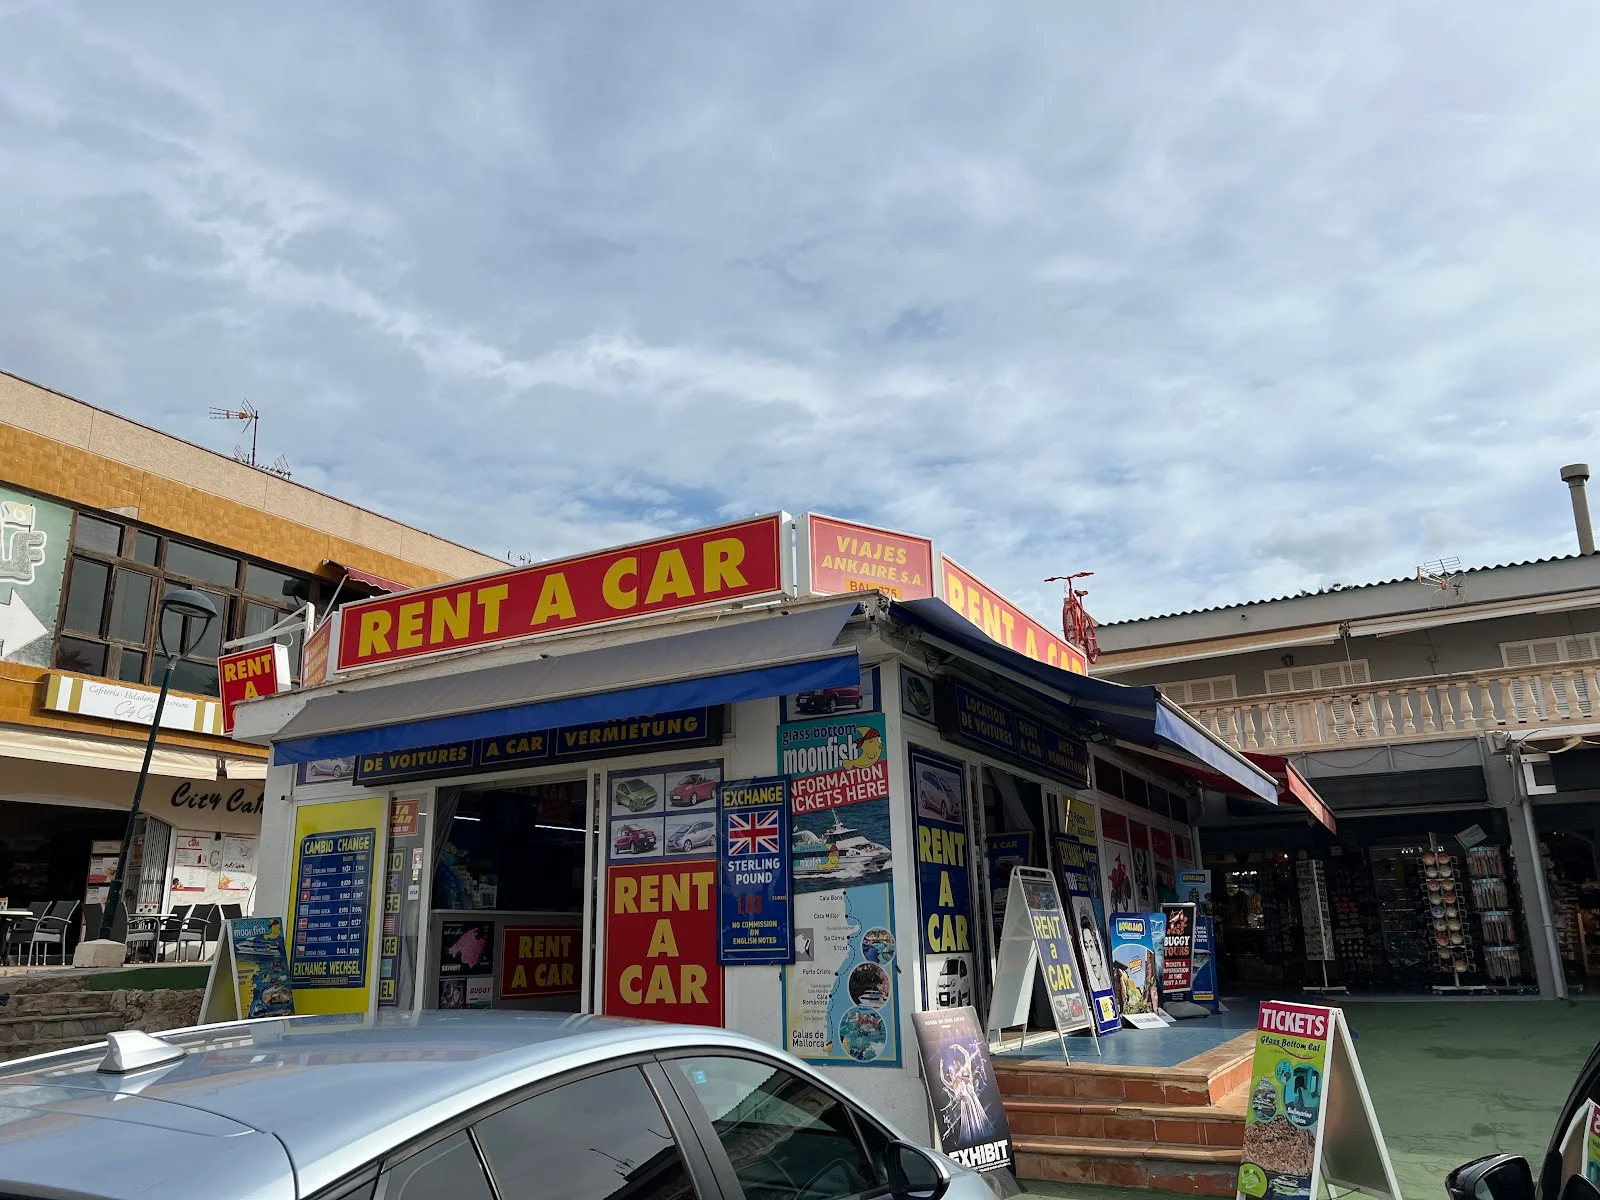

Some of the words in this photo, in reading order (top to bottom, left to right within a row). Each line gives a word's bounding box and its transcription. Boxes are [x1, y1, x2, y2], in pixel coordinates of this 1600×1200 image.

[837, 535, 907, 565] VIAJES
[357, 586, 509, 657] RENT
[530, 572, 576, 626] A
[602, 537, 749, 610] CAR
[947, 572, 1015, 650] RENT
[1025, 627, 1039, 662] A
[1047, 642, 1082, 676] CAR
[224, 654, 272, 683] RENT
[244, 681, 259, 701] A
[965, 695, 1006, 726] LOCATION
[565, 716, 699, 747] VERMIETUNG
[782, 728, 811, 746] glass
[813, 723, 857, 739] bottom
[960, 712, 973, 729] DE
[974, 716, 1013, 748] VOITURES
[1019, 720, 1039, 738] RENT
[363, 757, 383, 773] DE
[389, 745, 467, 769] VOITURES
[486, 742, 501, 757] A
[505, 736, 543, 755] CAR
[783, 734, 860, 774] moonfish
[1020, 739, 1026, 752] A
[1027, 742, 1043, 758] CAR
[1058, 739, 1074, 757] AUTO
[1048, 749, 1087, 777] VERMIETUNG
[791, 763, 884, 797] NFORMATION
[170, 782, 222, 810] City
[226, 788, 264, 814] Caf
[723, 786, 783, 807] EXCHANGE
[791, 789, 844, 814] ICKETS
[846, 780, 888, 803] HERE
[304, 840, 333, 854] CAMBIO
[337, 836, 370, 852] CHANGE
[919, 824, 965, 867] RENT
[1000, 840, 1018, 849] CAR
[728, 857, 781, 872] STERLING
[735, 871, 773, 885] POUND
[938, 870, 955, 907] A
[614, 871, 714, 914] RENT
[731, 921, 741, 929] NO
[741, 920, 778, 928] COMMISSION
[927, 913, 970, 953] CAR
[1034, 915, 1061, 940] RENT
[519, 936, 572, 959] RENT
[646, 918, 679, 958] A
[733, 937, 757, 945] ENGLISH
[758, 936, 777, 944] NOTES
[1164, 936, 1190, 947] BUGGY
[1050, 945, 1058, 959] a
[1164, 947, 1189, 956] TOURS
[293, 961, 327, 976] EXCHANGE
[329, 960, 360, 975] WECHSEL
[511, 965, 528, 989] A
[535, 963, 574, 987] CAR
[1048, 963, 1075, 991] CAR
[470, 987, 492, 995] BUGGY
[619, 964, 709, 1006] CAR
[792, 1030, 812, 1038] Calas
[1261, 1008, 1325, 1037] TICKETS
[792, 1038, 825, 1047] Mallorca
[1260, 1035, 1280, 1047] Glass
[1281, 1038, 1307, 1051] Bottom
[949, 1139, 1008, 1167] EXHIBIT
